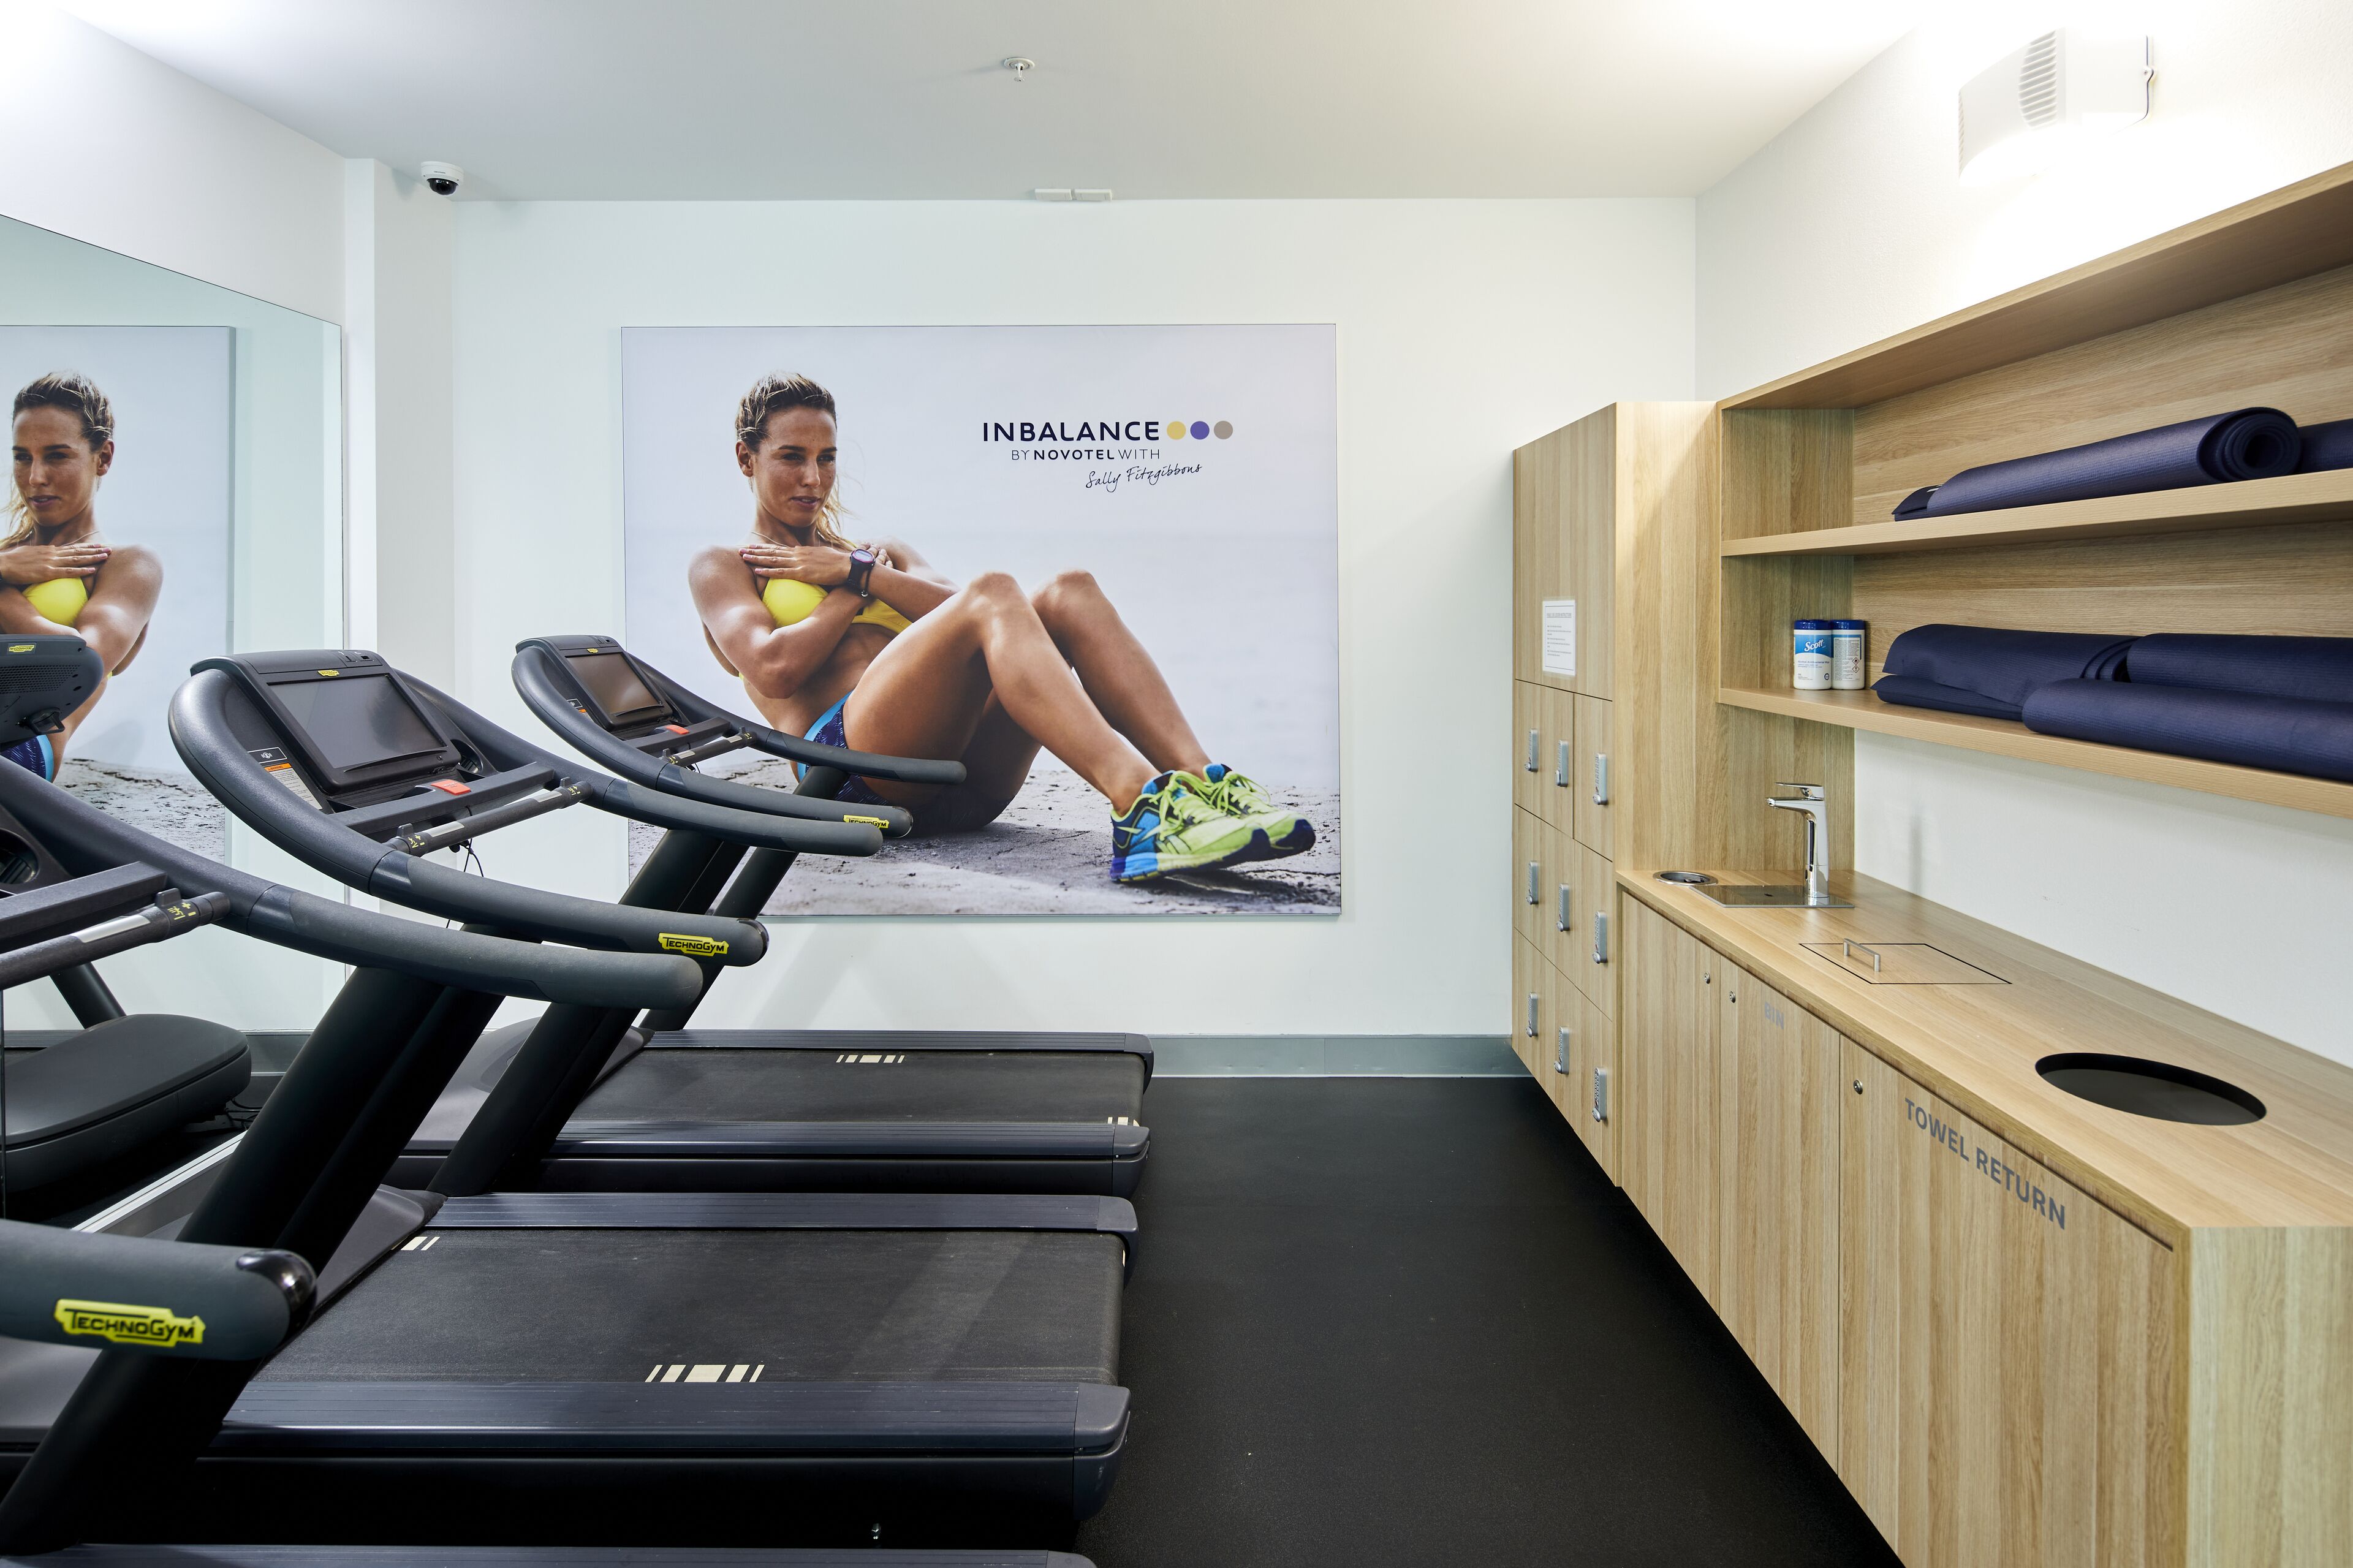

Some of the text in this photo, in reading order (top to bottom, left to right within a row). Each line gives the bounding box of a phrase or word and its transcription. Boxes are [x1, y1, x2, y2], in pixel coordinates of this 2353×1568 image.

[983, 421, 1159, 441] INBALANCE
[1011, 449, 1159, 460] BY NOVOTEL WITH
[1085, 463, 1203, 493] Sally Fitzgibbons
[1803, 638, 1824, 652] Scott
[1764, 1002, 1785, 1030] BIN
[1905, 1097, 2065, 1230] TOWEL RETURN
